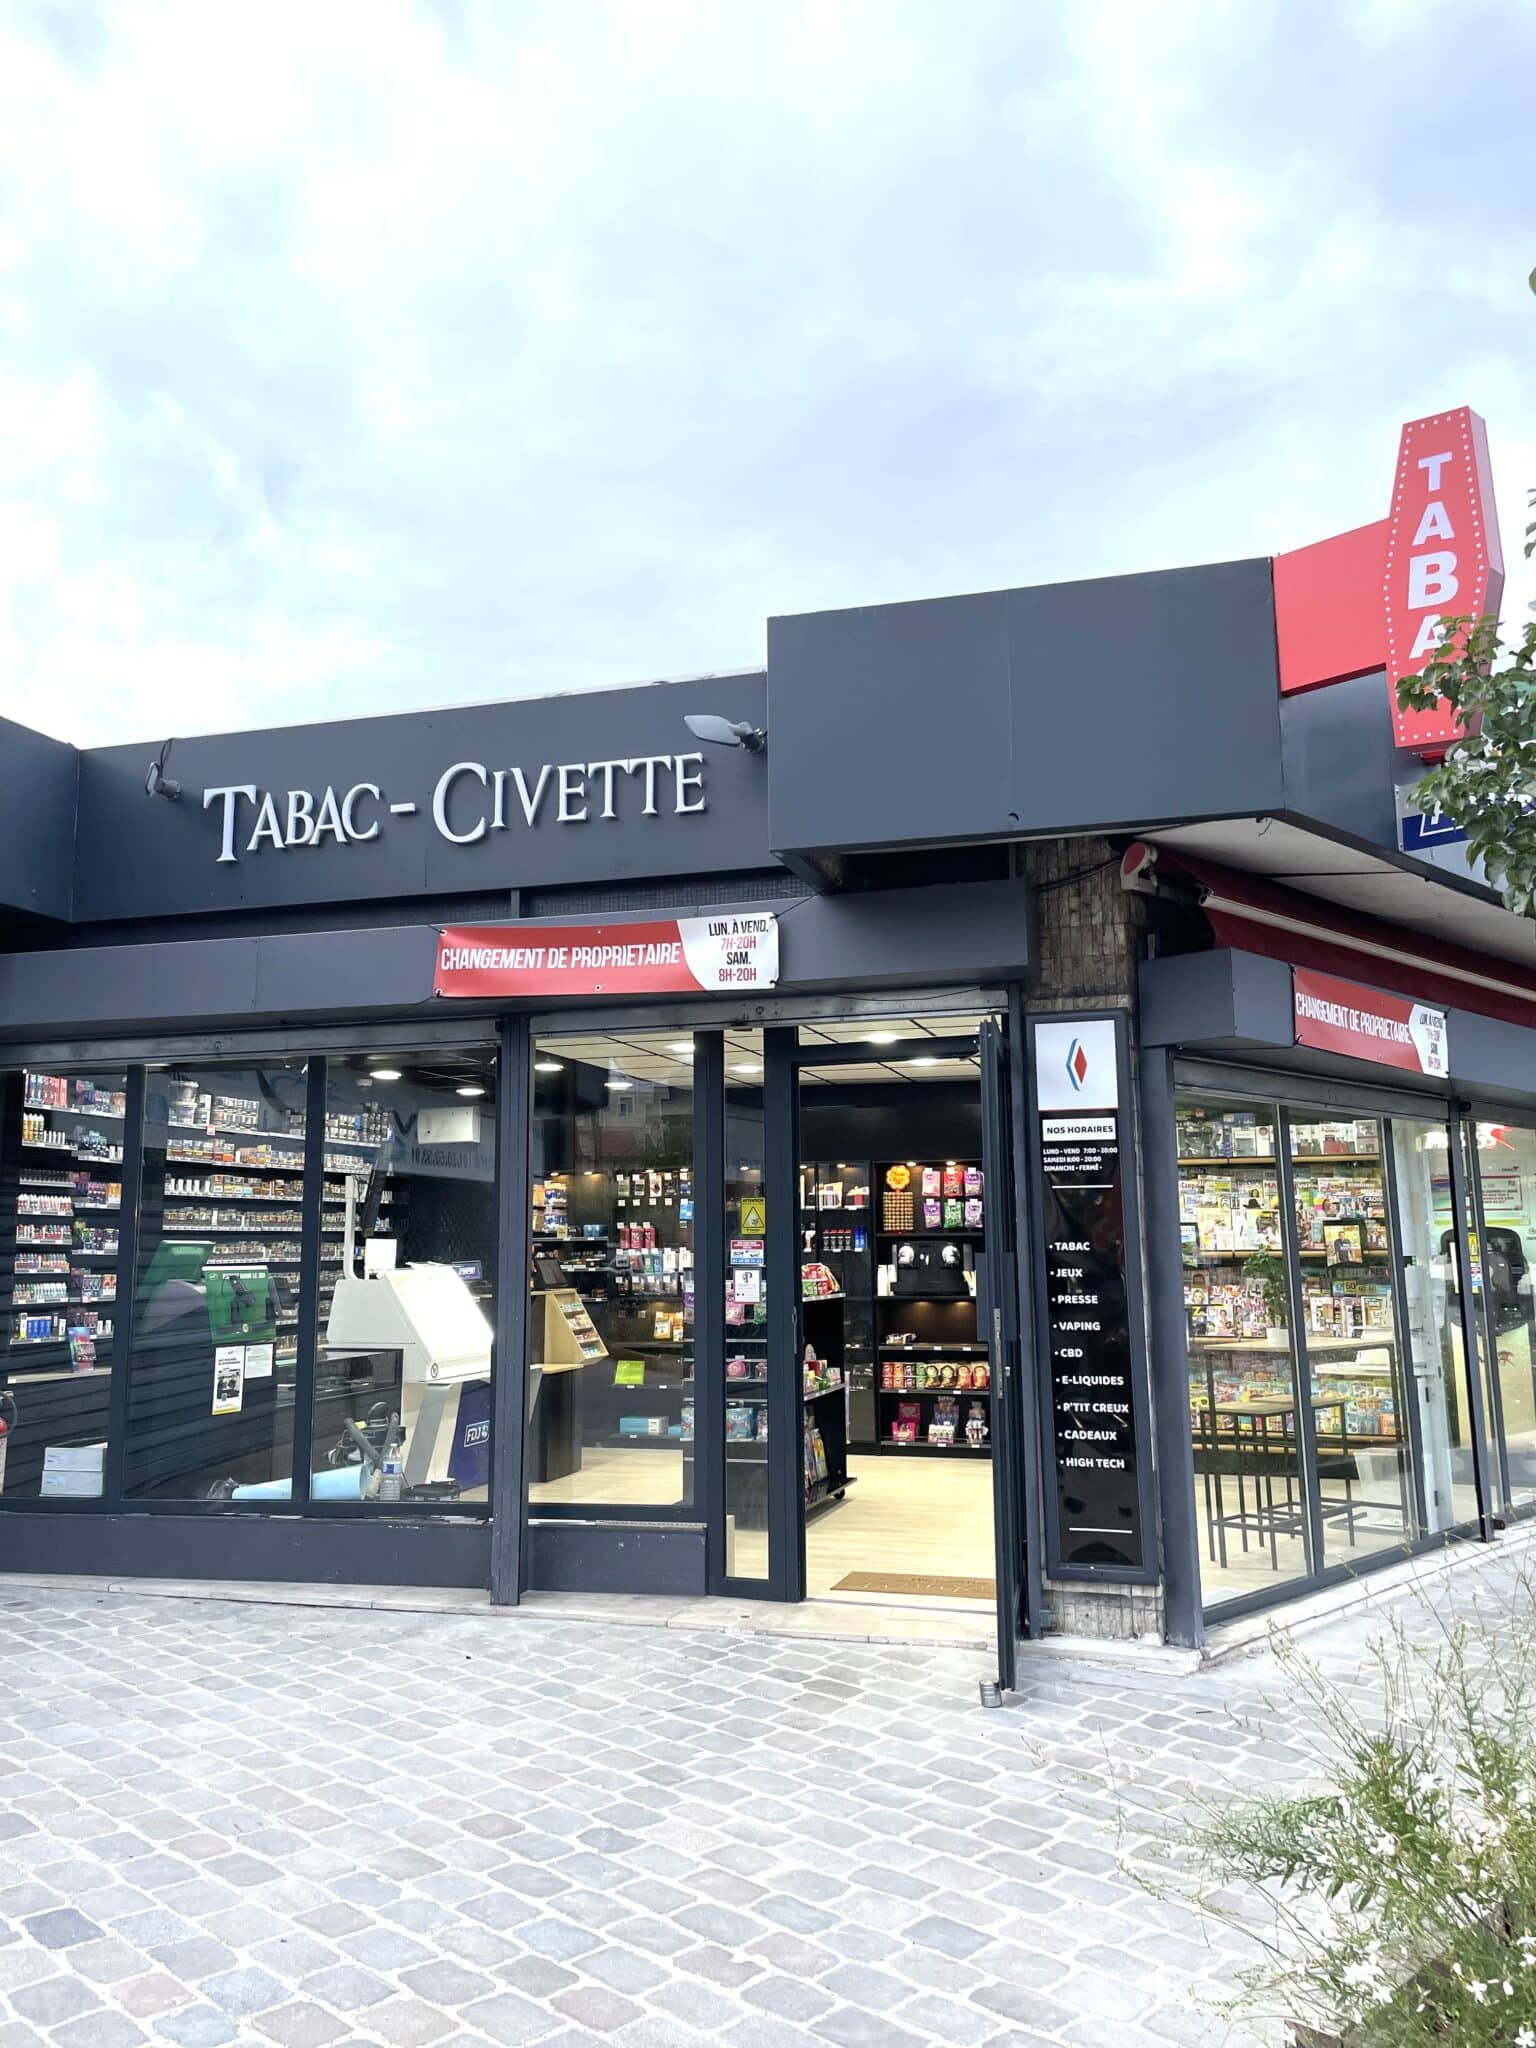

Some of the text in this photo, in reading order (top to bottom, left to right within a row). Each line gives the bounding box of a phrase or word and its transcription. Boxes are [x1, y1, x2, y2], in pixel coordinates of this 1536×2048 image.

[1407, 452, 1460, 697] TABA
[203, 783, 382, 862] TABAC
[432, 752, 706, 844] CIVETTE
[709, 919, 769, 936] LUN. À VEND.
[721, 935, 757, 950] 7H-20H
[440, 942, 681, 971] CHANGEMENT DE PROPRIETAIRE
[726, 951, 752, 965] SAM.
[718, 968, 757, 982] 8H-20H
[1295, 992, 1413, 1045] CHANGEMENT DE PROPRIETAIRE
[1047, 1125, 1114, 1135] NOS HORAIRES
[1054, 1241, 1091, 1251] TABAC
[1056, 1268, 1083, 1278] JEUX
[1057, 1295, 1099, 1304] PRESSE
[1059, 1322, 1101, 1331] VAPING
[1060, 1348, 1083, 1358] CBD
[1062, 1375, 1124, 1387] E-LIQUIDES
[1063, 1402, 1129, 1413] P'TIT CREUX
[467, 1426, 482, 1443] FDJ
[1064, 1430, 1117, 1440] CADEAUX
[1065, 1457, 1125, 1468] HIGH TECH
